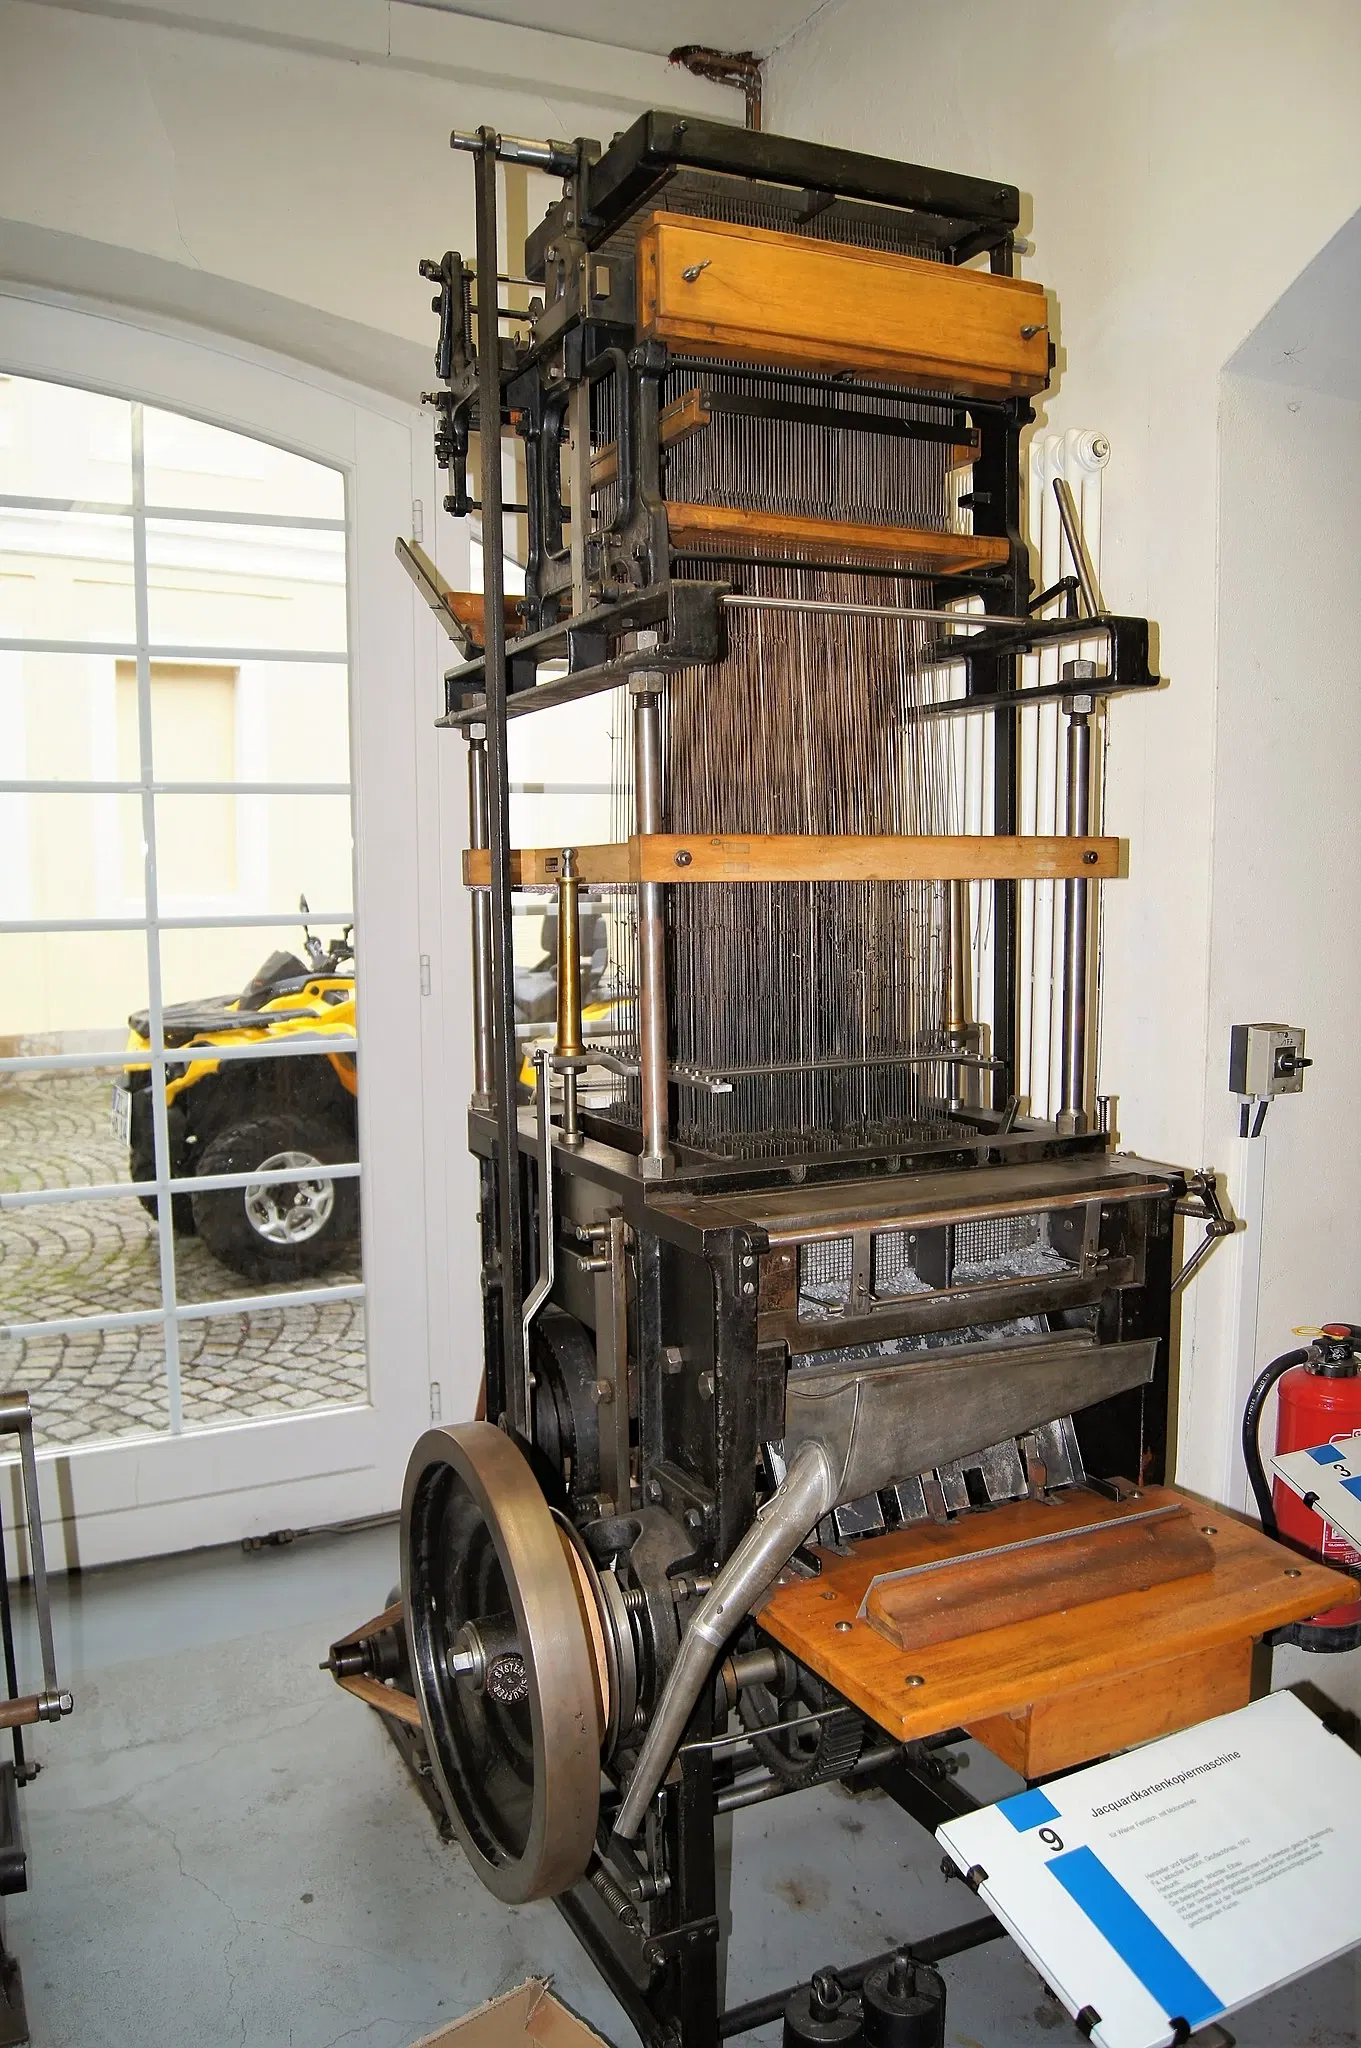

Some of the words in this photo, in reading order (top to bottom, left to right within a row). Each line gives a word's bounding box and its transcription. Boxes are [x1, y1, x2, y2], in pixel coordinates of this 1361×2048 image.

[1256, 1373, 1270, 1393] GLORIA
[1333, 1464, 1351, 1477] 3
[494, 1662, 526, 1678] SYSTEM
[493, 1678, 528, 1701] STAUFFER
[1091, 1750, 1241, 1818] Jacquardkartenkopiermaschine
[1039, 1827, 1064, 1851] 9
